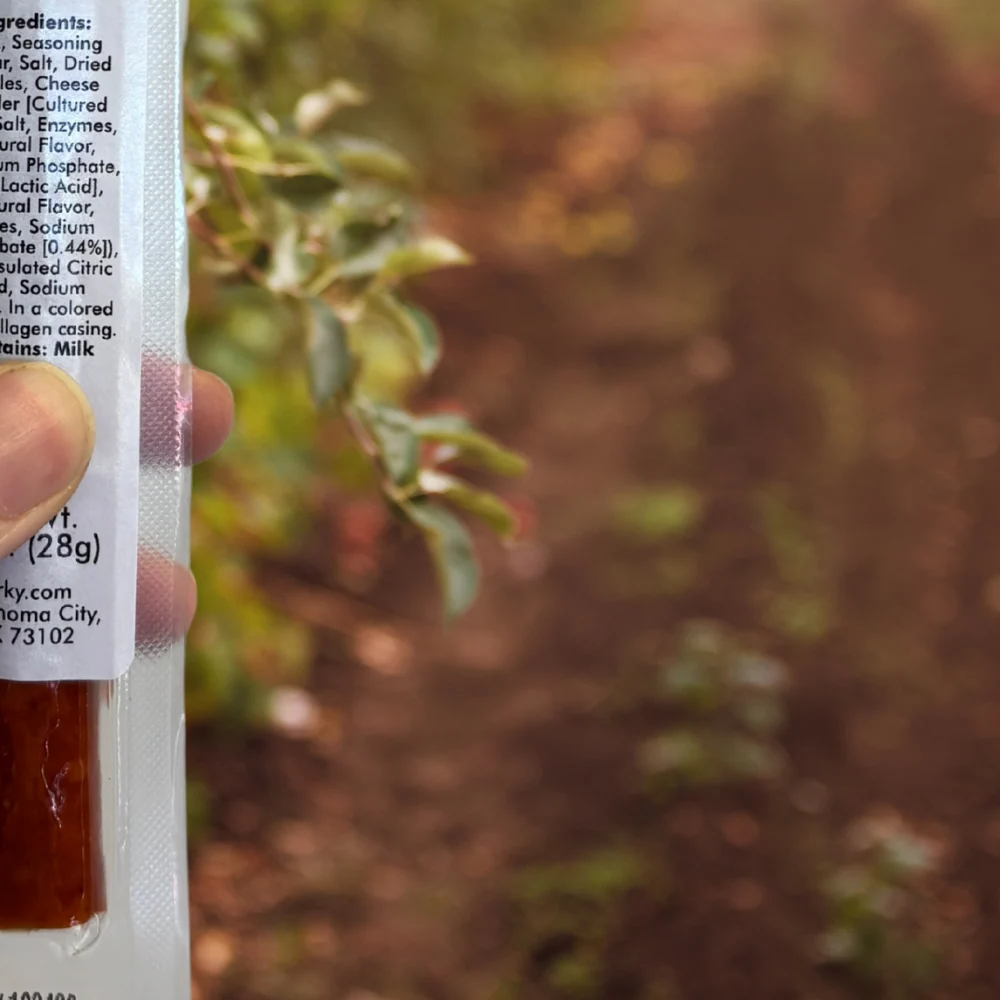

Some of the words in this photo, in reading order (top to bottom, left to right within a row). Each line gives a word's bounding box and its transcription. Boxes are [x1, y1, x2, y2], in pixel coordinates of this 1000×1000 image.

[12, 35, 103, 54] Seasoning
[20, 55, 58, 73] Salt,
[64, 56, 112, 72] Dried
[35, 75, 100, 92] Cheese
[26, 95, 108, 115] [Cultured
[38, 117, 117, 136] Enzymes,
[39, 137, 95, 156] Flavor,
[27, 158, 120, 177] Phosphate,
[1, 177, 49, 193] Lactic
[54, 178, 104, 197] Acid],
[38, 198, 95, 217] Flavor,
[29, 218, 95, 234] Sodium
[43, 240, 119, 259] [0.44%]),
[67, 260, 113, 276] Citric
[20, 279, 86, 295] Sodium
[9, 299, 24, 315] In
[31, 304, 41, 315] a
[48, 300, 113, 317] colored
[59, 321, 117, 340] casing.
[53, 341, 95, 357] Milk
[29, 533, 100, 565] (28g)
[59, 604, 101, 626] City,
[11, 627, 74, 645] 73102
